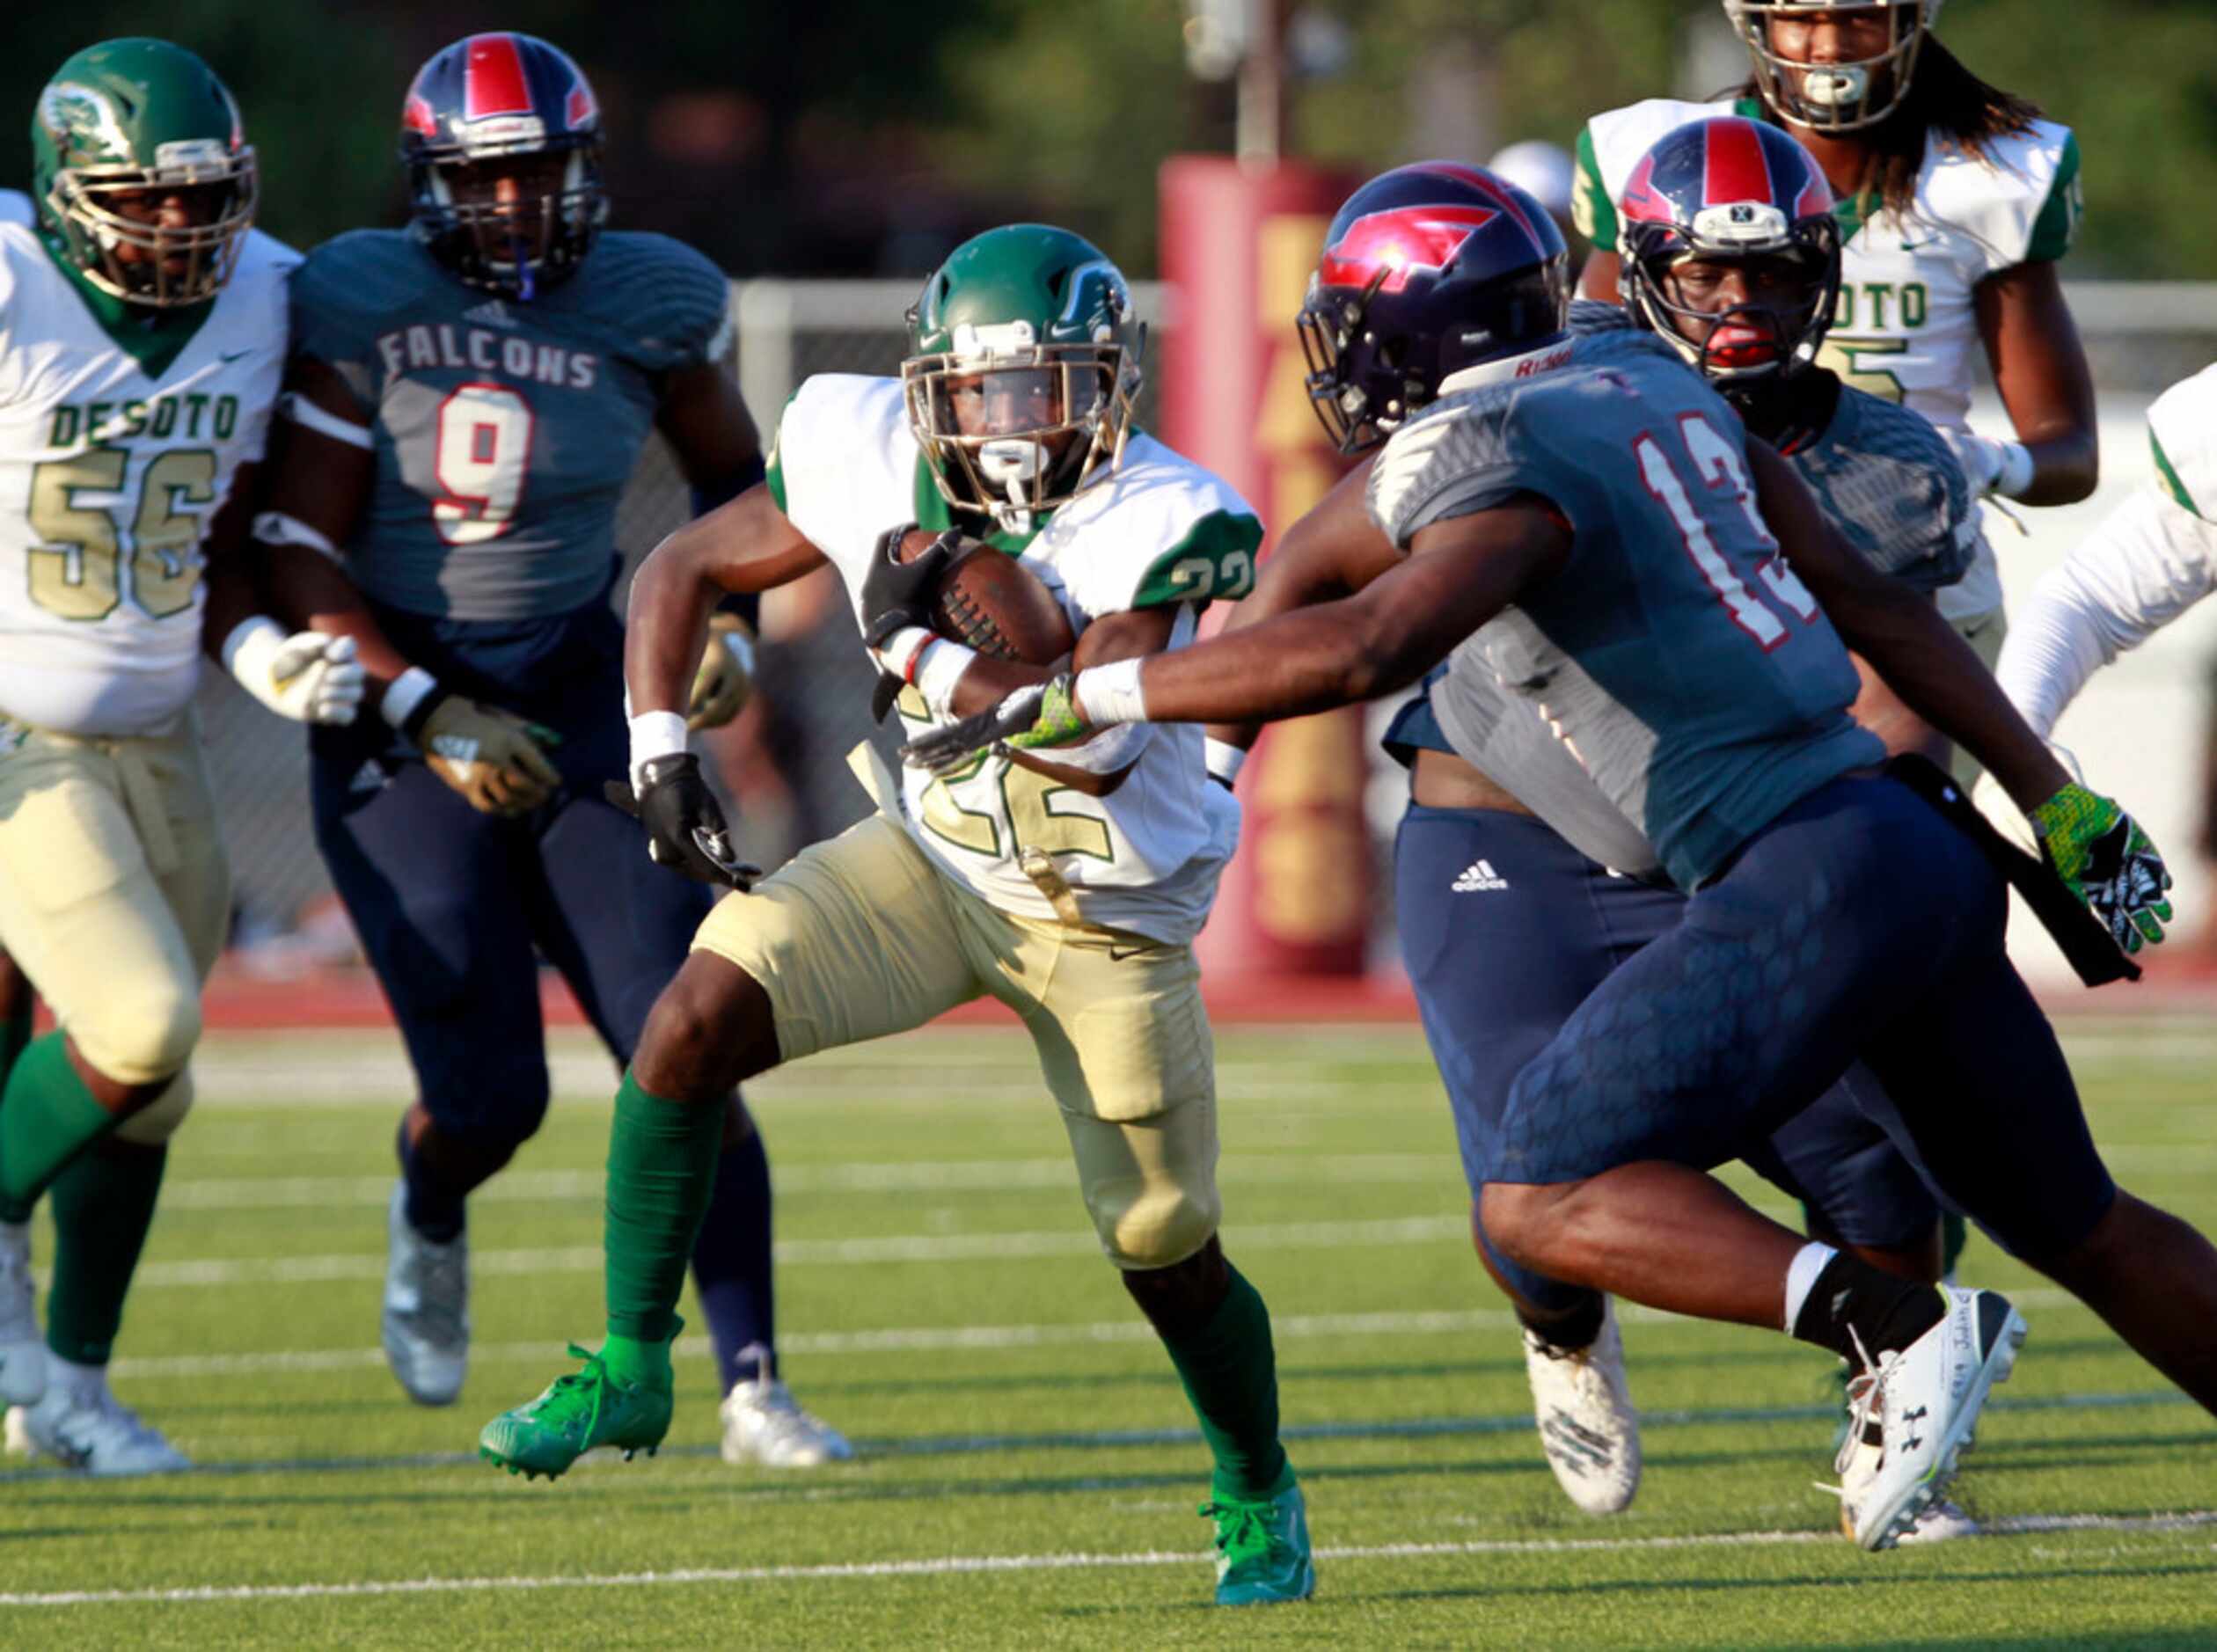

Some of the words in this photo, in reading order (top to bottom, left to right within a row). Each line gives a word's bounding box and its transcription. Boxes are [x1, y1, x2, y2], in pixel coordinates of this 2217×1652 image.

[1833, 282, 1927, 328] OTO
[377, 324, 596, 389] FALCONS
[1814, 337, 1907, 406] 5
[50, 392, 238, 448] DESOTO
[431, 382, 535, 545] 9
[26, 447, 216, 621] 56
[1171, 549, 1250, 601] 22
[1451, 878, 1508, 892] adidas
